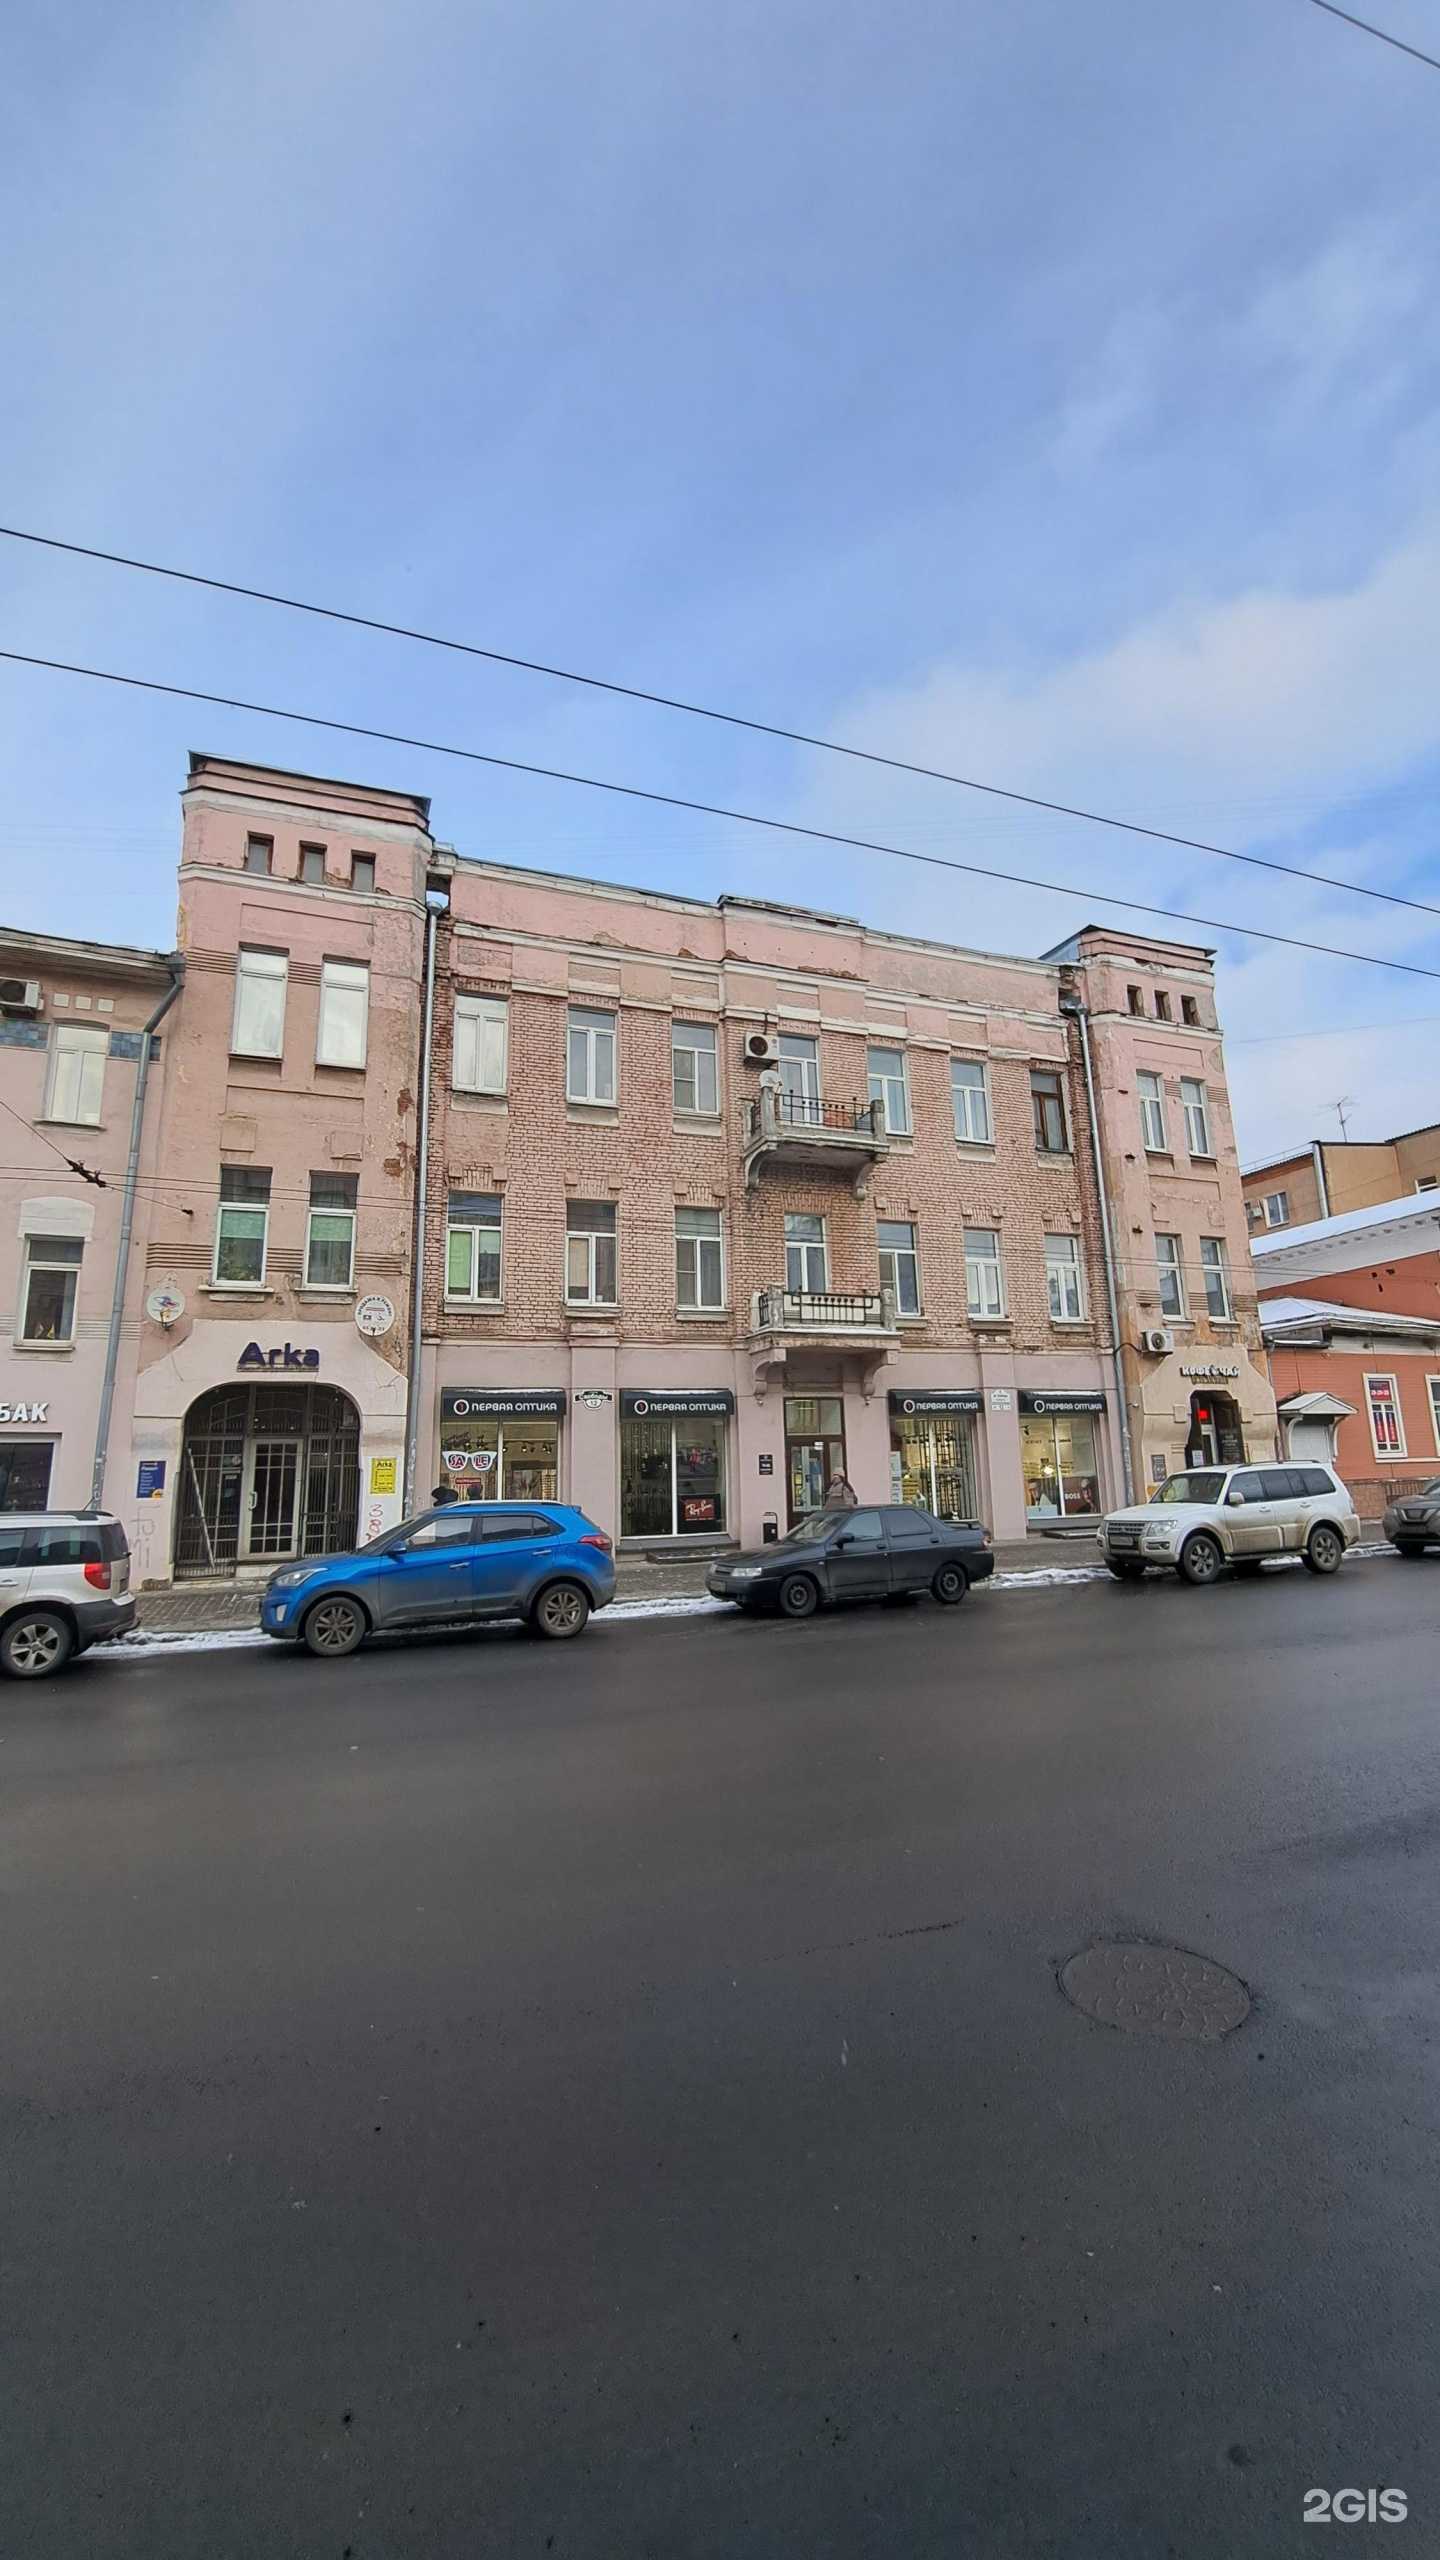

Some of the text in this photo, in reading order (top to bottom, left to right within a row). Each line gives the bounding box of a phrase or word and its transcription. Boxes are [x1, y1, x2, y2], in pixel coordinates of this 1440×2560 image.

[238, 1342, 319, 1366] Arka
[472, 1403, 557, 1411] ПЕРВАЯ ОПТИКА
[650, 1403, 726, 1411] ПЕРВАЯ ОПТИКА
[916, 1402, 978, 1410] ПЕРВАЯ ОПТИКА
